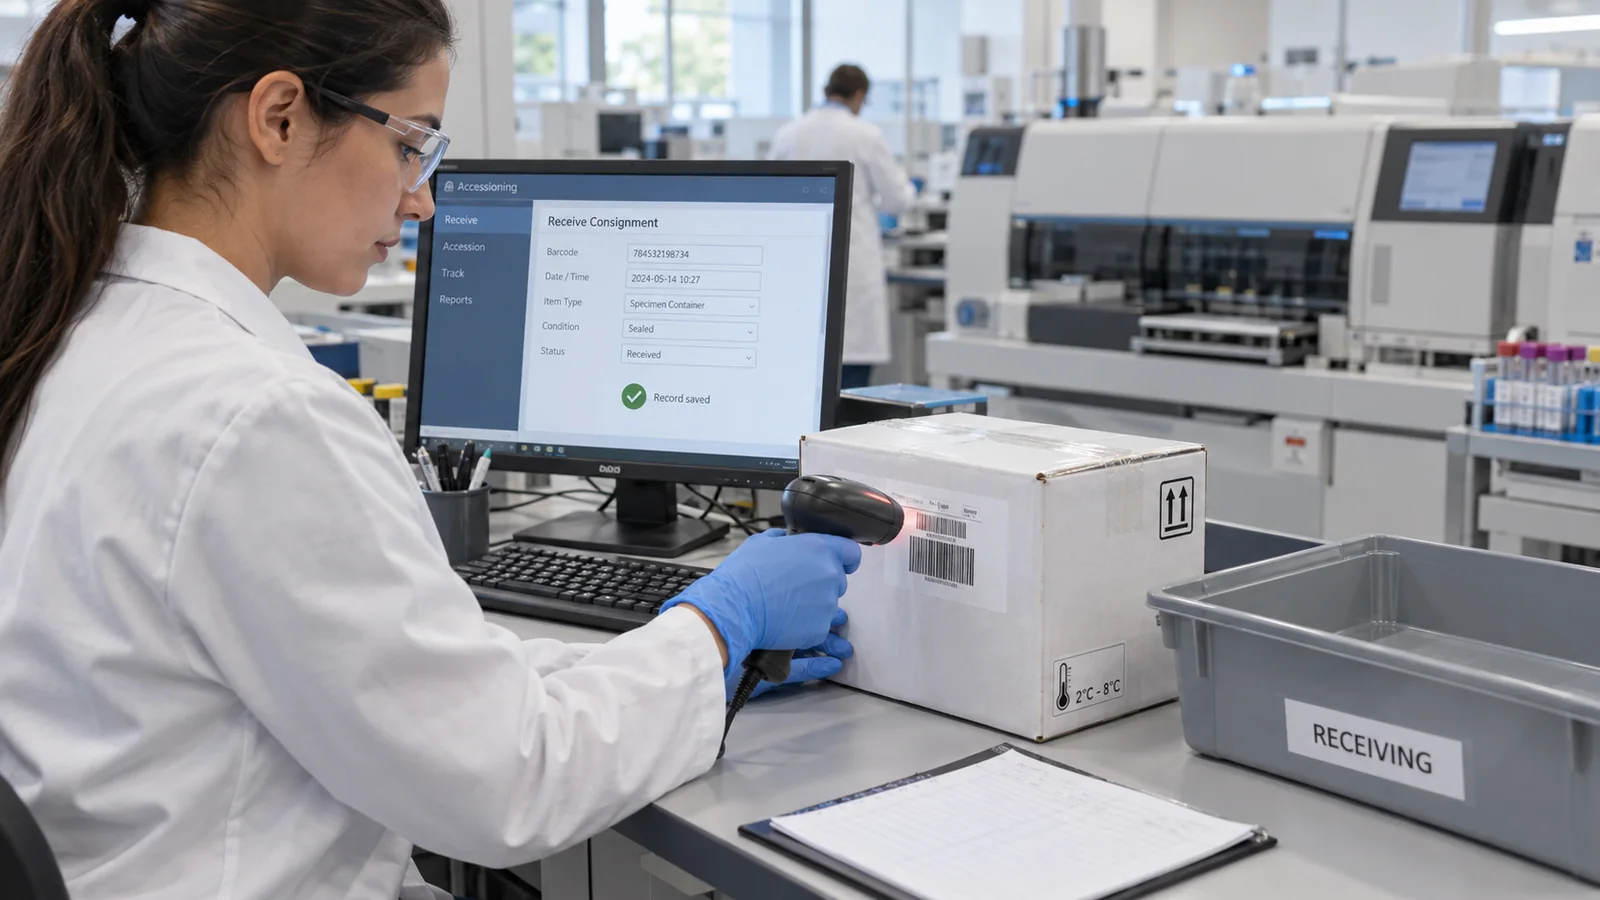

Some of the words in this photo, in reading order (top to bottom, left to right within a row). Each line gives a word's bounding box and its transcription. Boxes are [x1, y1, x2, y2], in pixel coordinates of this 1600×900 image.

[457, 182, 517, 194] Accessioning
[445, 214, 478, 225] Receive
[548, 216, 587, 227] Receive
[590, 217, 658, 230] Consignment
[443, 241, 485, 252] Accession
[547, 247, 578, 257] Barcode
[442, 268, 465, 278] Track
[545, 272, 563, 282] Date
[571, 272, 589, 282] Time
[632, 274, 676, 284] 2024-05-14
[680, 275, 701, 284] 10:27
[440, 294, 472, 306] Reports
[544, 297, 561, 306] Item
[563, 297, 582, 309] Type
[630, 299, 667, 311] Specimen
[668, 300, 705, 310] Container
[542, 321, 580, 331] Condition
[629, 324, 654, 334] Sealed
[541, 346, 565, 356] Status
[627, 350, 661, 360] Received
[654, 393, 683, 403] Record
[685, 394, 710, 405] saved
[1076, 687, 1094, 703] 2°C
[1103, 679, 1121, 695] 8°C
[1312, 723, 1433, 774] RECEIVING
